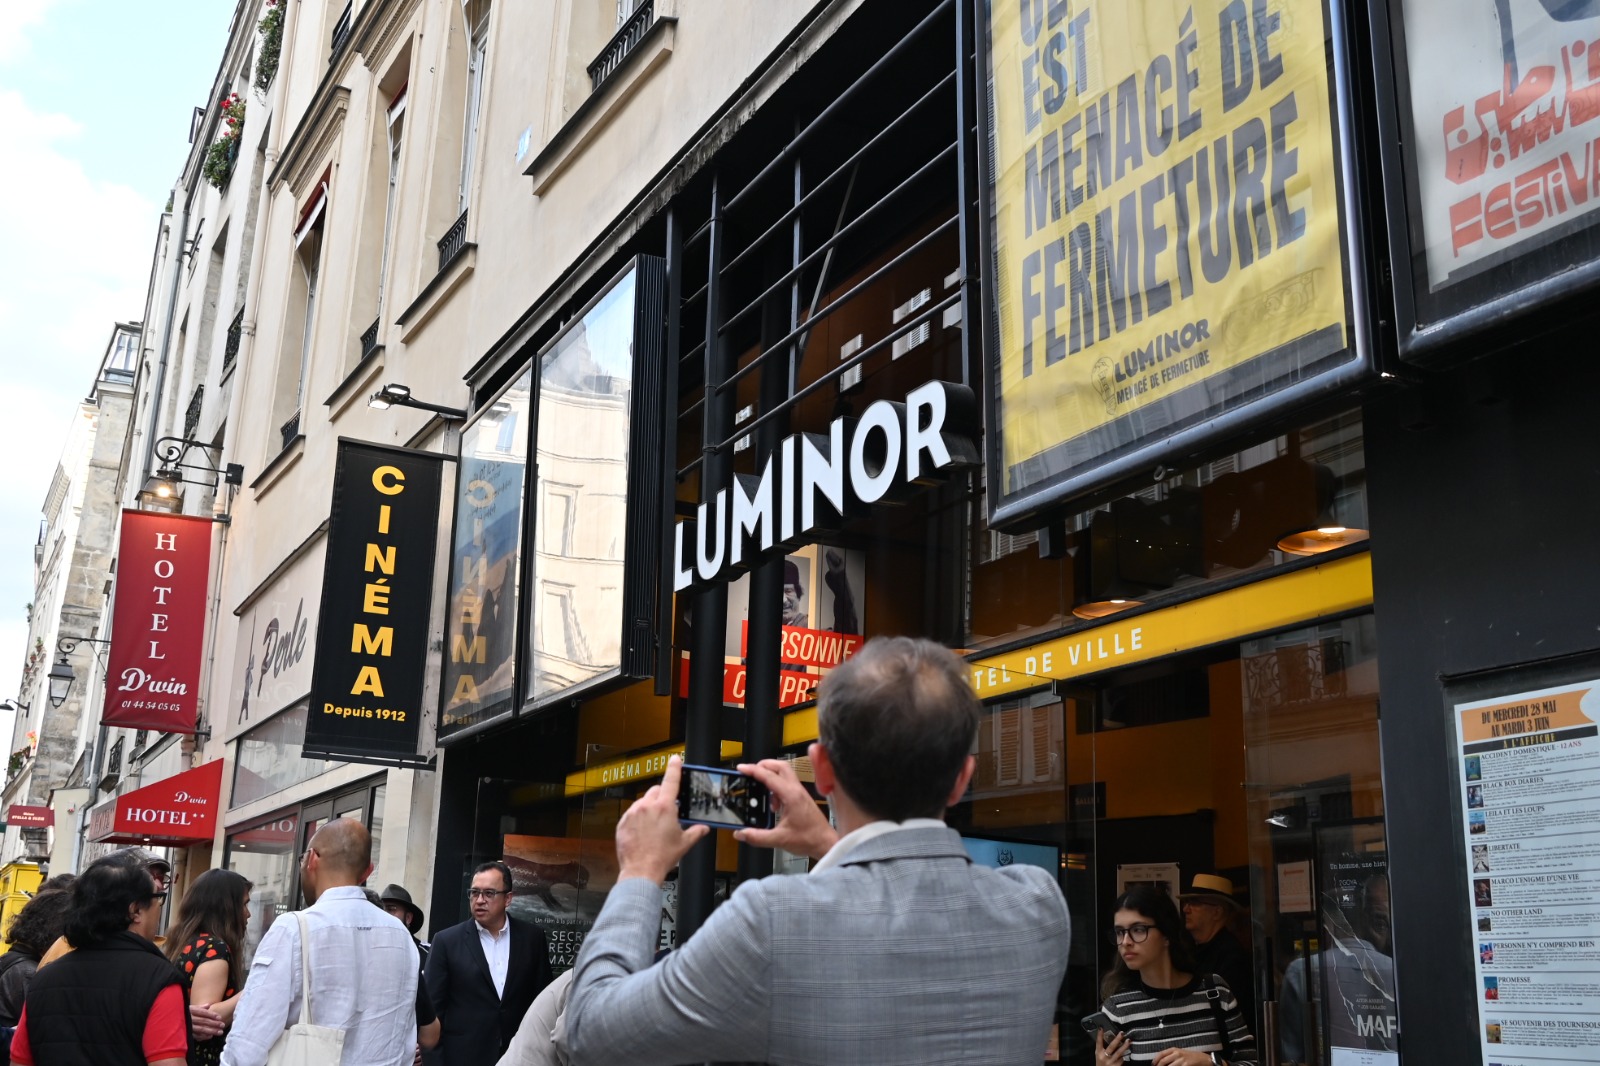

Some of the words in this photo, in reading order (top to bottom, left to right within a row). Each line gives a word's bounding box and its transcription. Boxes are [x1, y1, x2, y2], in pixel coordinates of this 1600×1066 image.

[1021, 7, 1090, 136] EST
[1024, 4, 1202, 240] MENACÉ
[1218, 0, 1284, 114] DE
[1022, 92, 1306, 379] FERMETURE
[1114, 318, 1210, 383] LUMINOR
[1116, 376, 1148, 404] MENACÉ
[1150, 372, 1160, 390] DE
[1161, 349, 1210, 384] FERMETURE
[674, 380, 951, 593] LUMINOR
[350, 465, 406, 698] CINÉMA
[148, 532, 177, 660] HOTEL
[1026, 652, 1052, 677] DE
[1068, 628, 1143, 666] VILLE
[133, 701, 144, 709] 44
[169, 704, 180, 712] 05
[324, 703, 373, 718] Depuis
[376, 708, 406, 722] 1912
[1482, 711, 1490, 724] DU
[1493, 704, 1528, 722] MERCREDI
[1530, 703, 1540, 717] 28
[1542, 700, 1556, 714] MAI
[1491, 724, 1500, 738] AU
[1502, 720, 1526, 736] MARDI
[1527, 719, 1533, 732] 3
[1534, 716, 1550, 732] JUIN
[1481, 750, 1512, 760] ACCIDENT
[1514, 744, 1556, 756] DOMESTIQUE
[602, 762, 640, 784] CINÉMA
[1483, 780, 1504, 790] BLACK
[1504, 778, 1516, 787] BOX
[1518, 776, 1544, 786] DIARIES
[126, 808, 191, 826] HOTEL
[1485, 809, 1503, 817] LEILA
[1524, 805, 1545, 813] LOUPS
[1488, 843, 1520, 852] LIBERTATE
[1491, 877, 1515, 886] MARCO
[1547, 874, 1567, 882] D'UNE
[1557, 1020, 1600, 1028] TOURNESOLS
